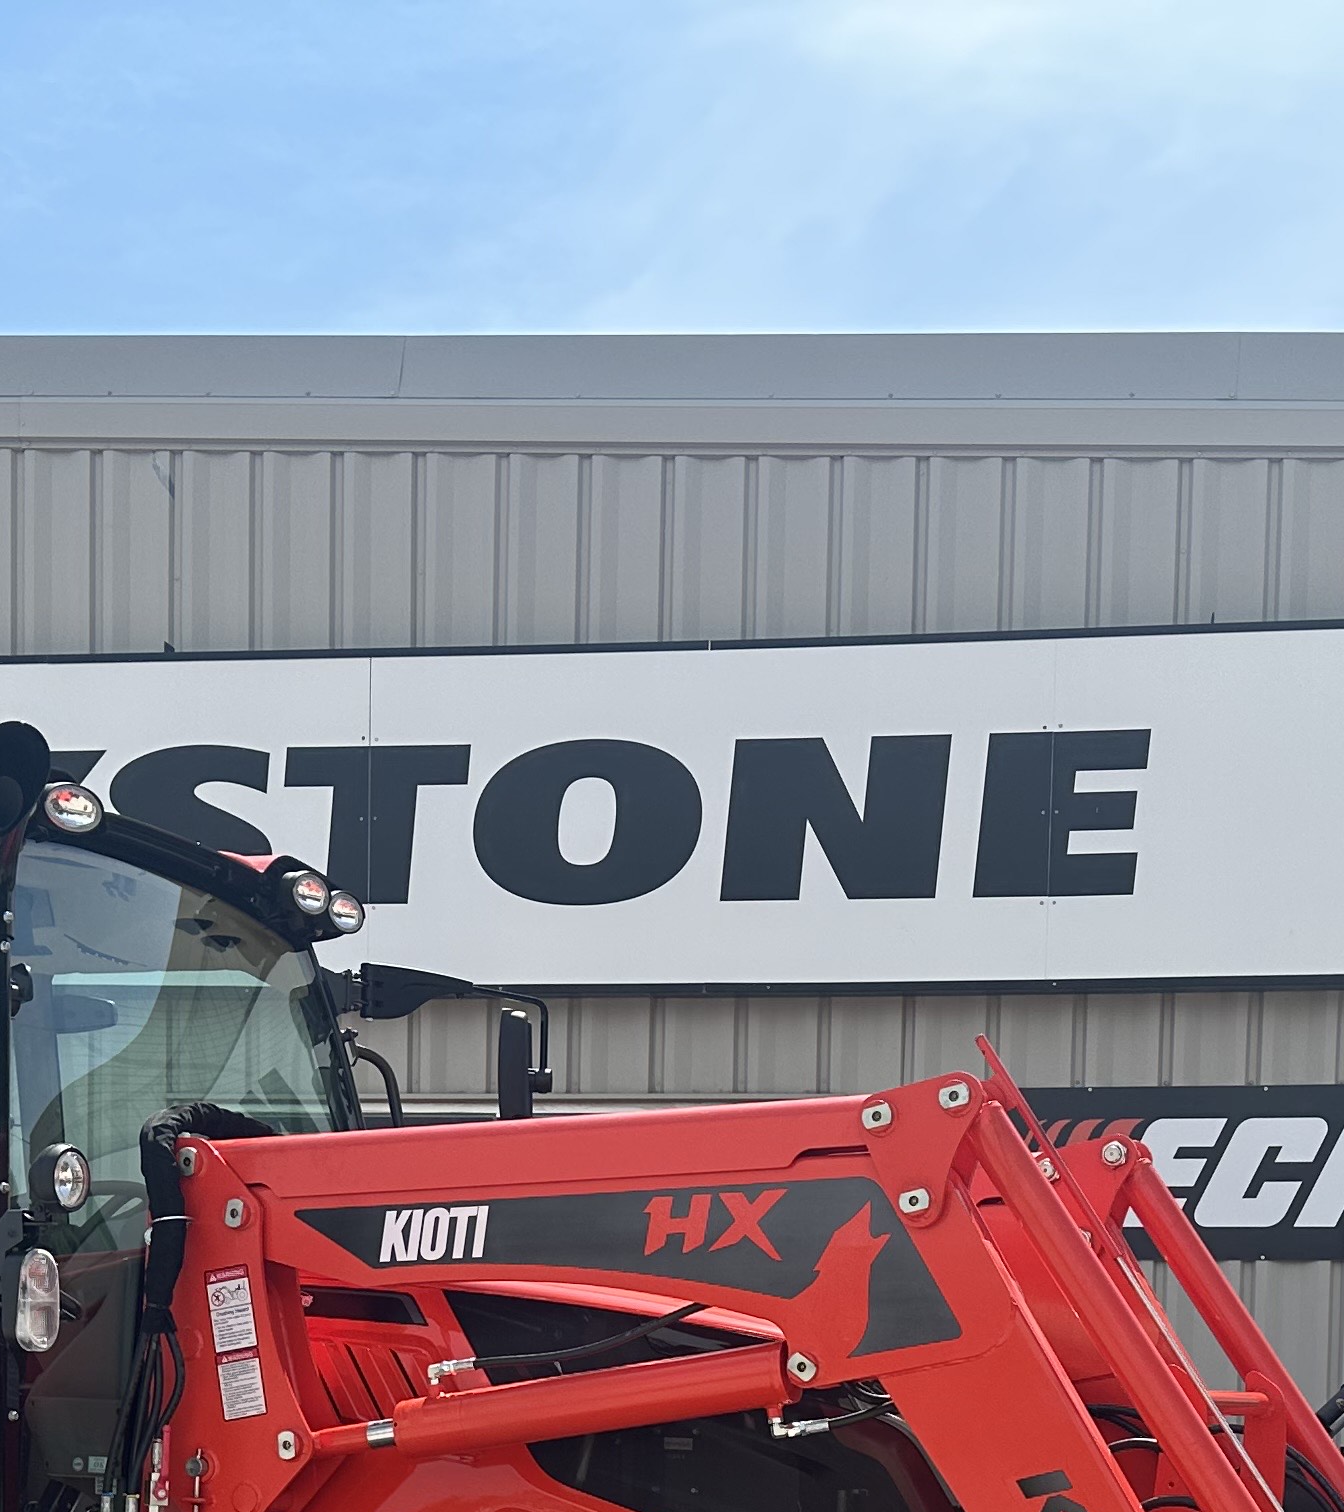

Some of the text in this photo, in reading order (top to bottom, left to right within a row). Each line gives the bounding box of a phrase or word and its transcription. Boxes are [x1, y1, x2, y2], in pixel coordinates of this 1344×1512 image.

[50, 728, 1151, 906] STONE
[379, 1188, 790, 1264] KIOTI HX
